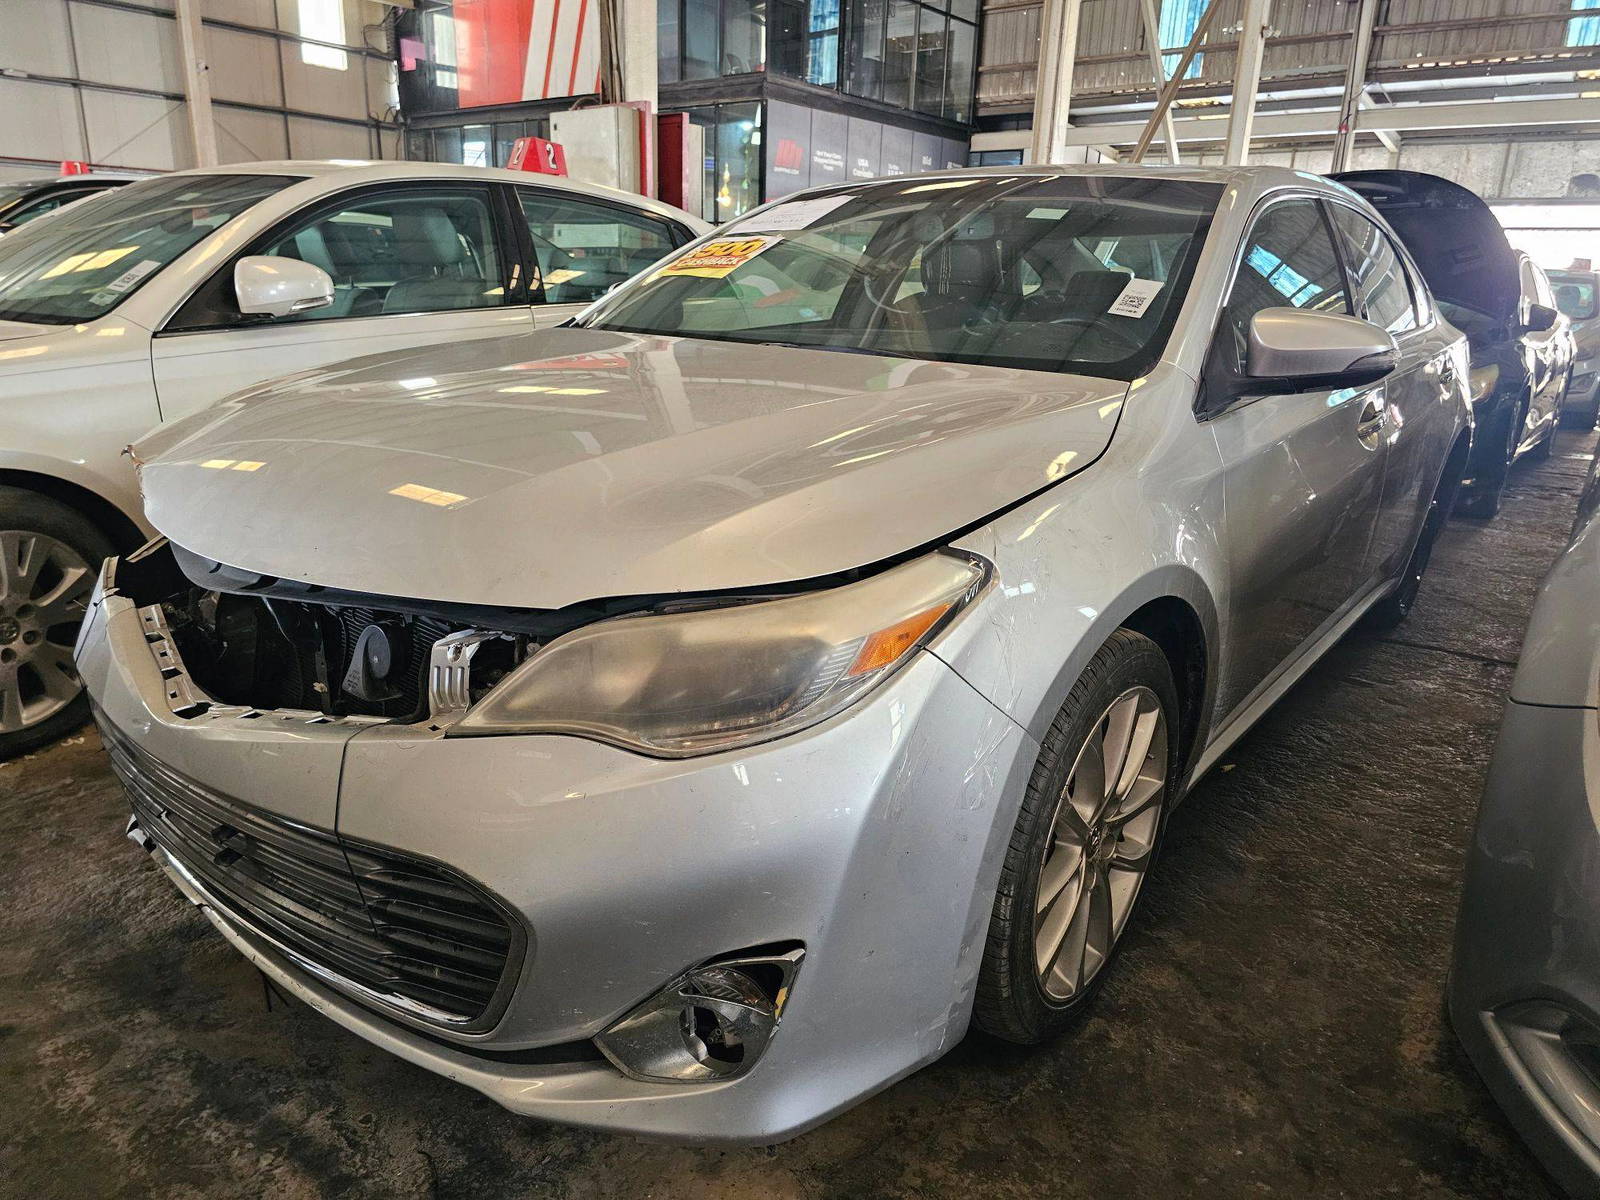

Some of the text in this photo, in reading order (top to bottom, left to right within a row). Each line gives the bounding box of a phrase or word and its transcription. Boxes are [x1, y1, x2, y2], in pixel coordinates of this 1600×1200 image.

[546, 143, 557, 169] 2
[857, 158, 869, 167] USA
[693, 239, 765, 257] 500
[678, 257, 741, 267] CASHBACK
